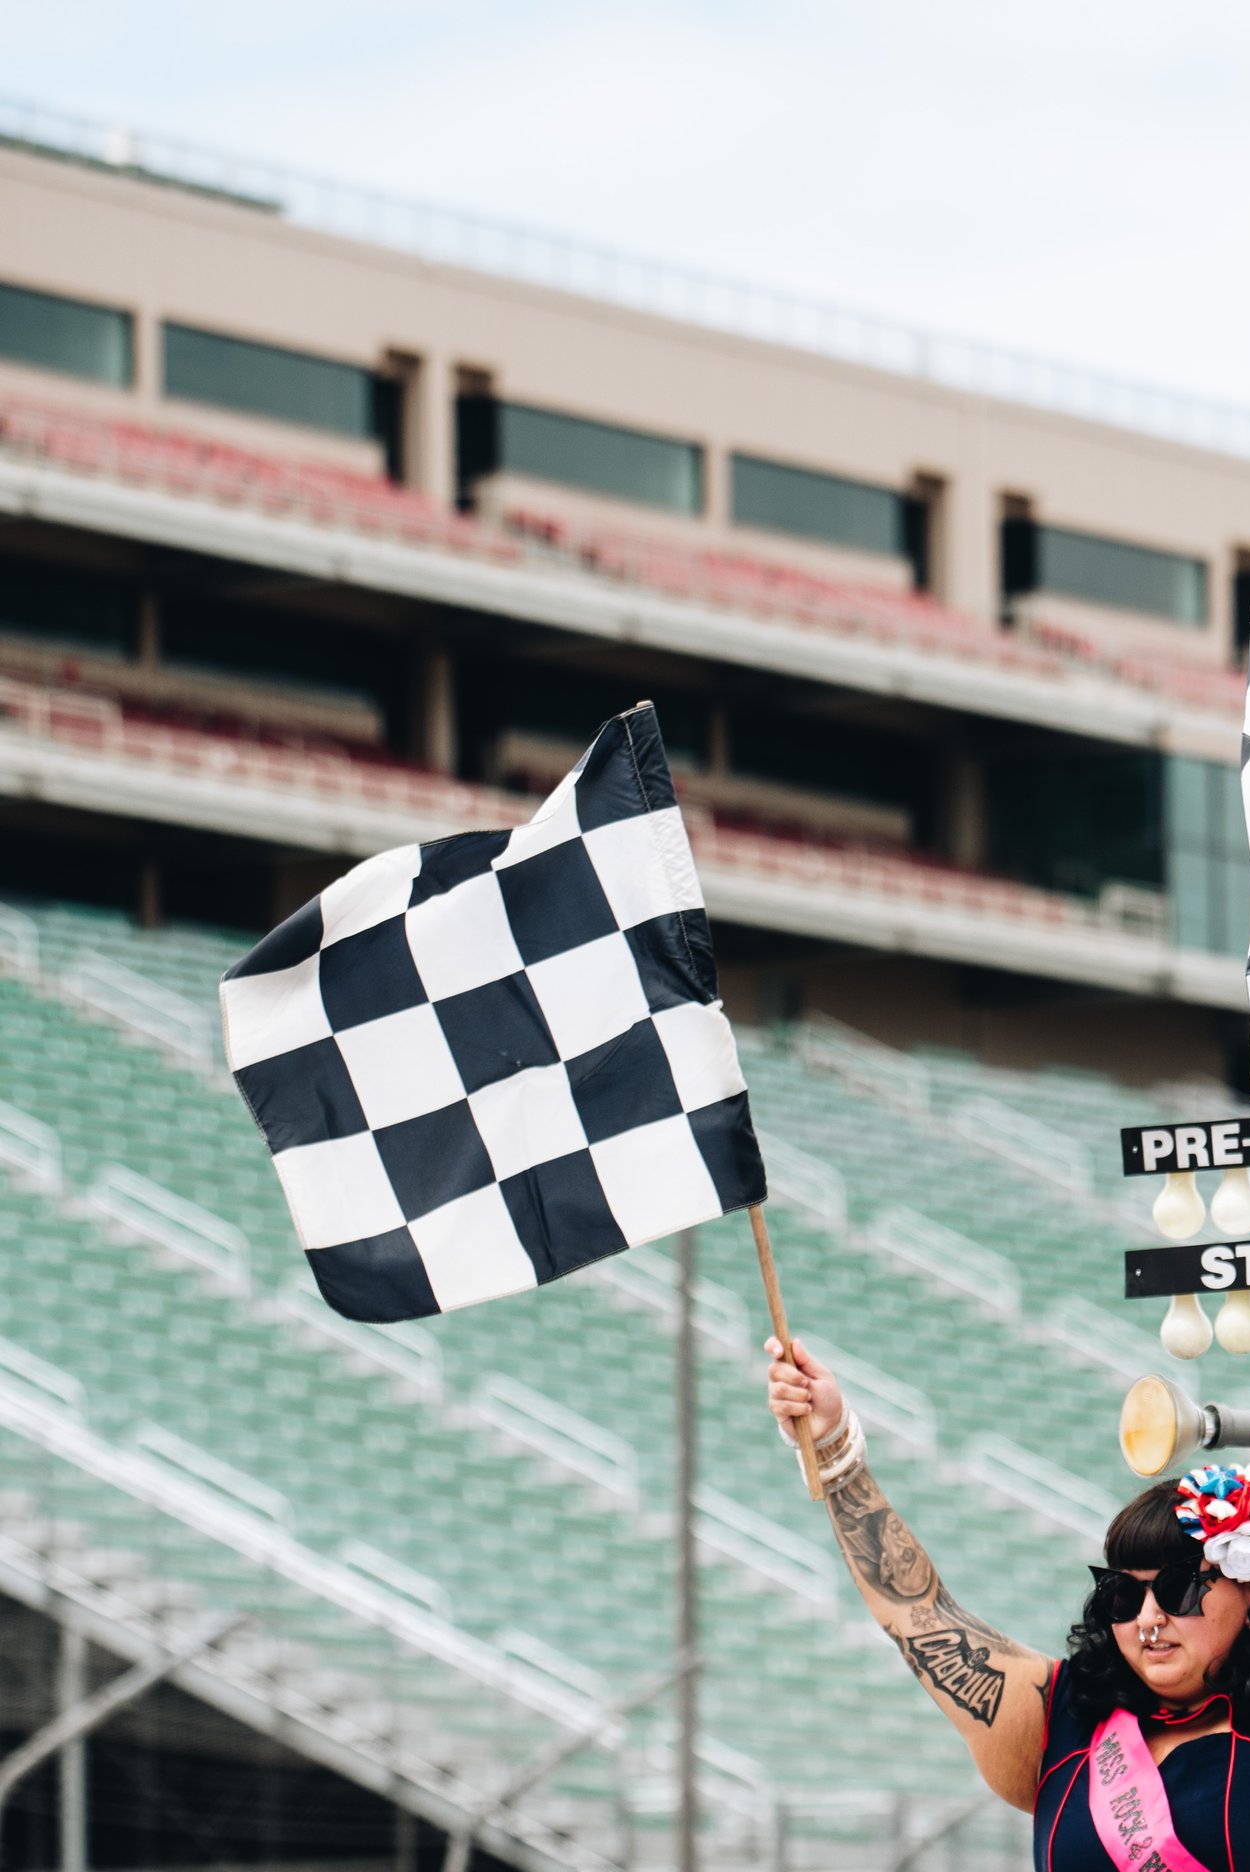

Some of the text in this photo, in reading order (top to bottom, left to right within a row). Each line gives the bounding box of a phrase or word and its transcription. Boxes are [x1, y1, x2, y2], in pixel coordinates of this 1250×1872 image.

[912, 1631, 1002, 1718] CHOCULA
[1095, 1731, 1128, 1786] MISS
[1109, 1786, 1148, 1846] ROCK
